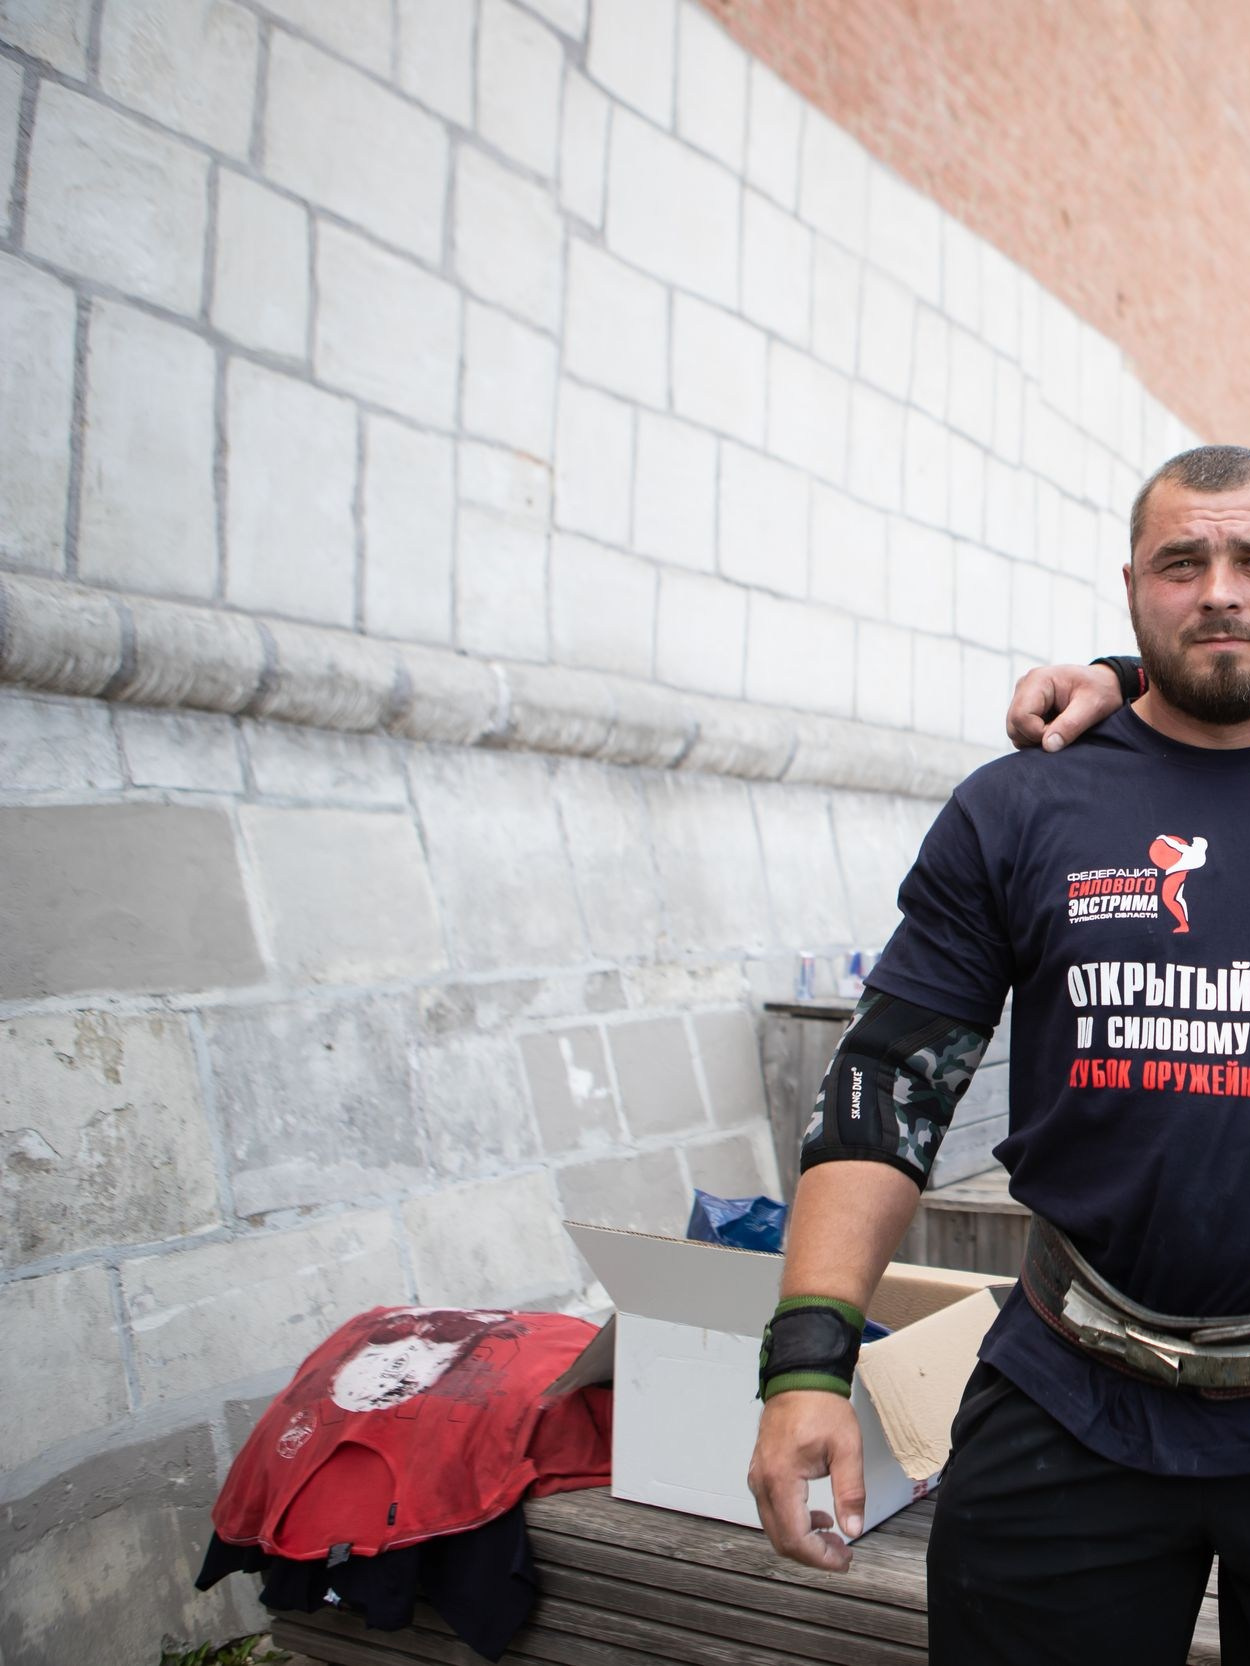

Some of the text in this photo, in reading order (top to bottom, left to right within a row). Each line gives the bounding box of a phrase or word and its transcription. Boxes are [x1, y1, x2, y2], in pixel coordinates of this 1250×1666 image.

[1067, 868, 1158, 882] ФЕДЕРАЦИЯ
[1068, 877, 1157, 898] СИЛОВОГО
[1068, 894, 1158, 917] ЭКСТРИМА
[1069, 912, 1113, 924] ТУЛЬСКОЙ
[1107, 1015, 1250, 1055] СИЛОВОМУ
[851, 1090, 862, 1119] SKANG
